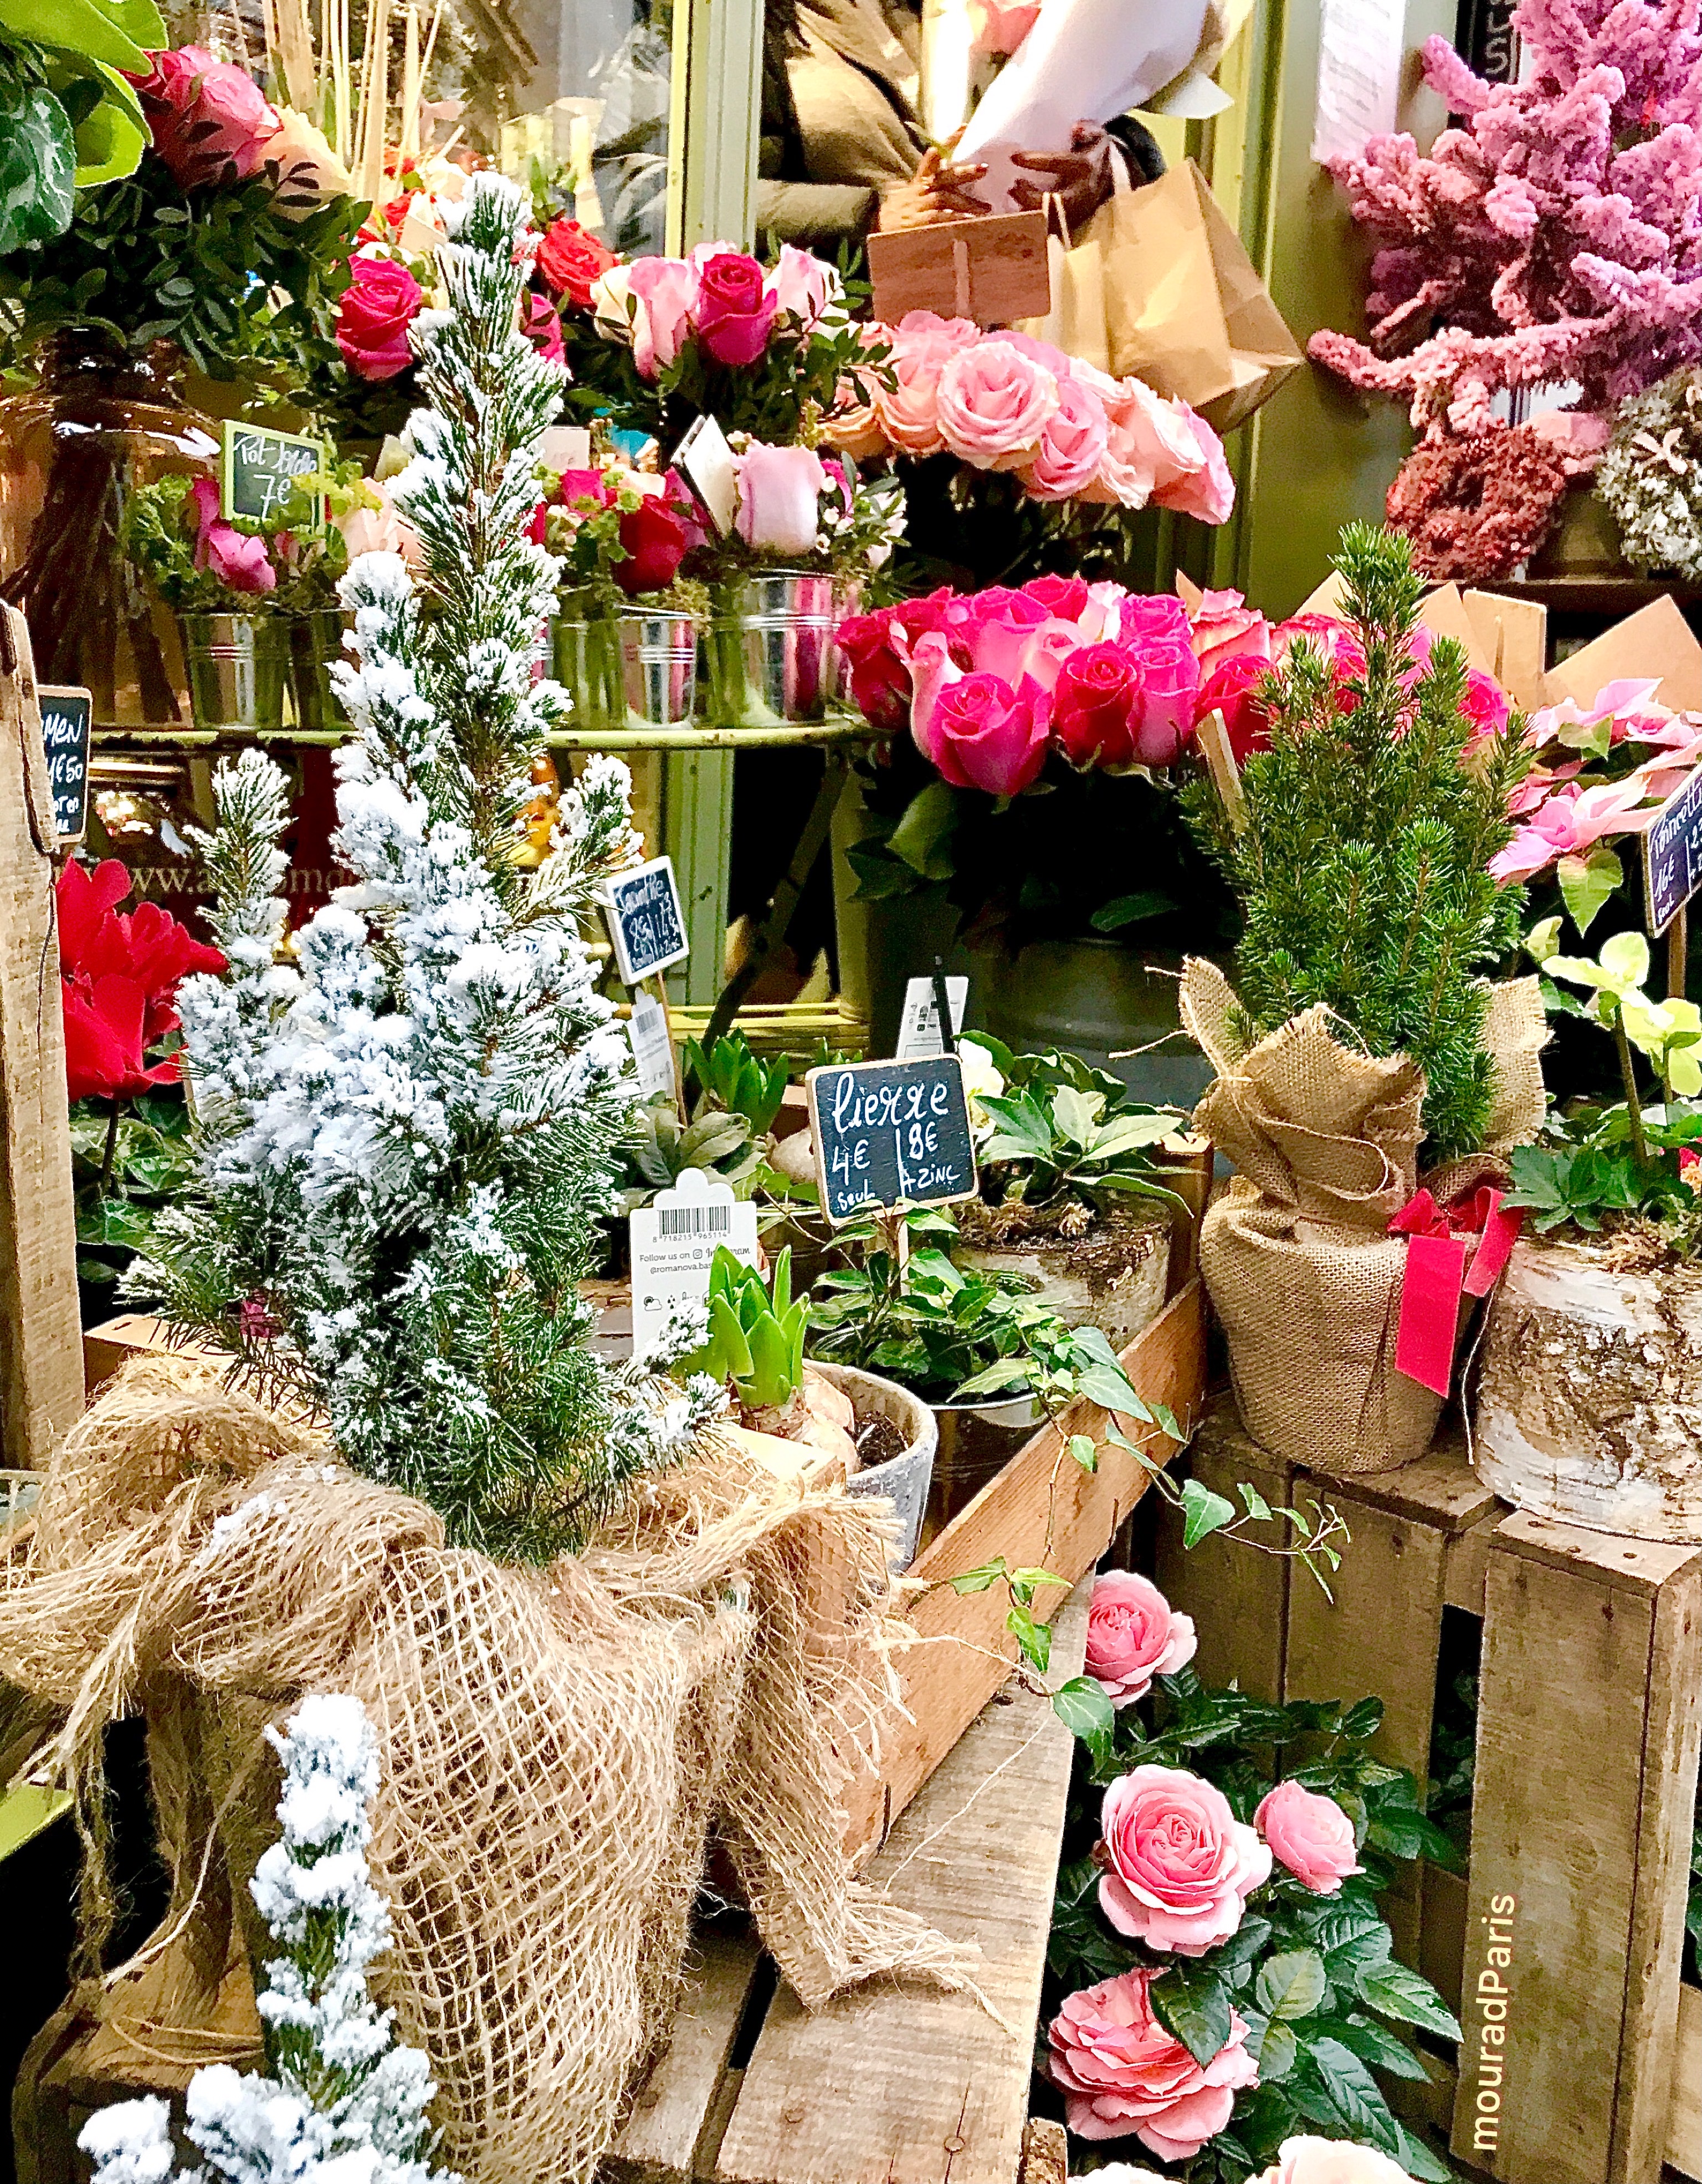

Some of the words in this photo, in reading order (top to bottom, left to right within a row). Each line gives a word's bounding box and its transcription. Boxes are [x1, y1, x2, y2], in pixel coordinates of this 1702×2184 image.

[832, 1139, 870, 1186] 4€
[698, 1229, 727, 1239] 965114
[639, 1254, 665, 1262] Follow
